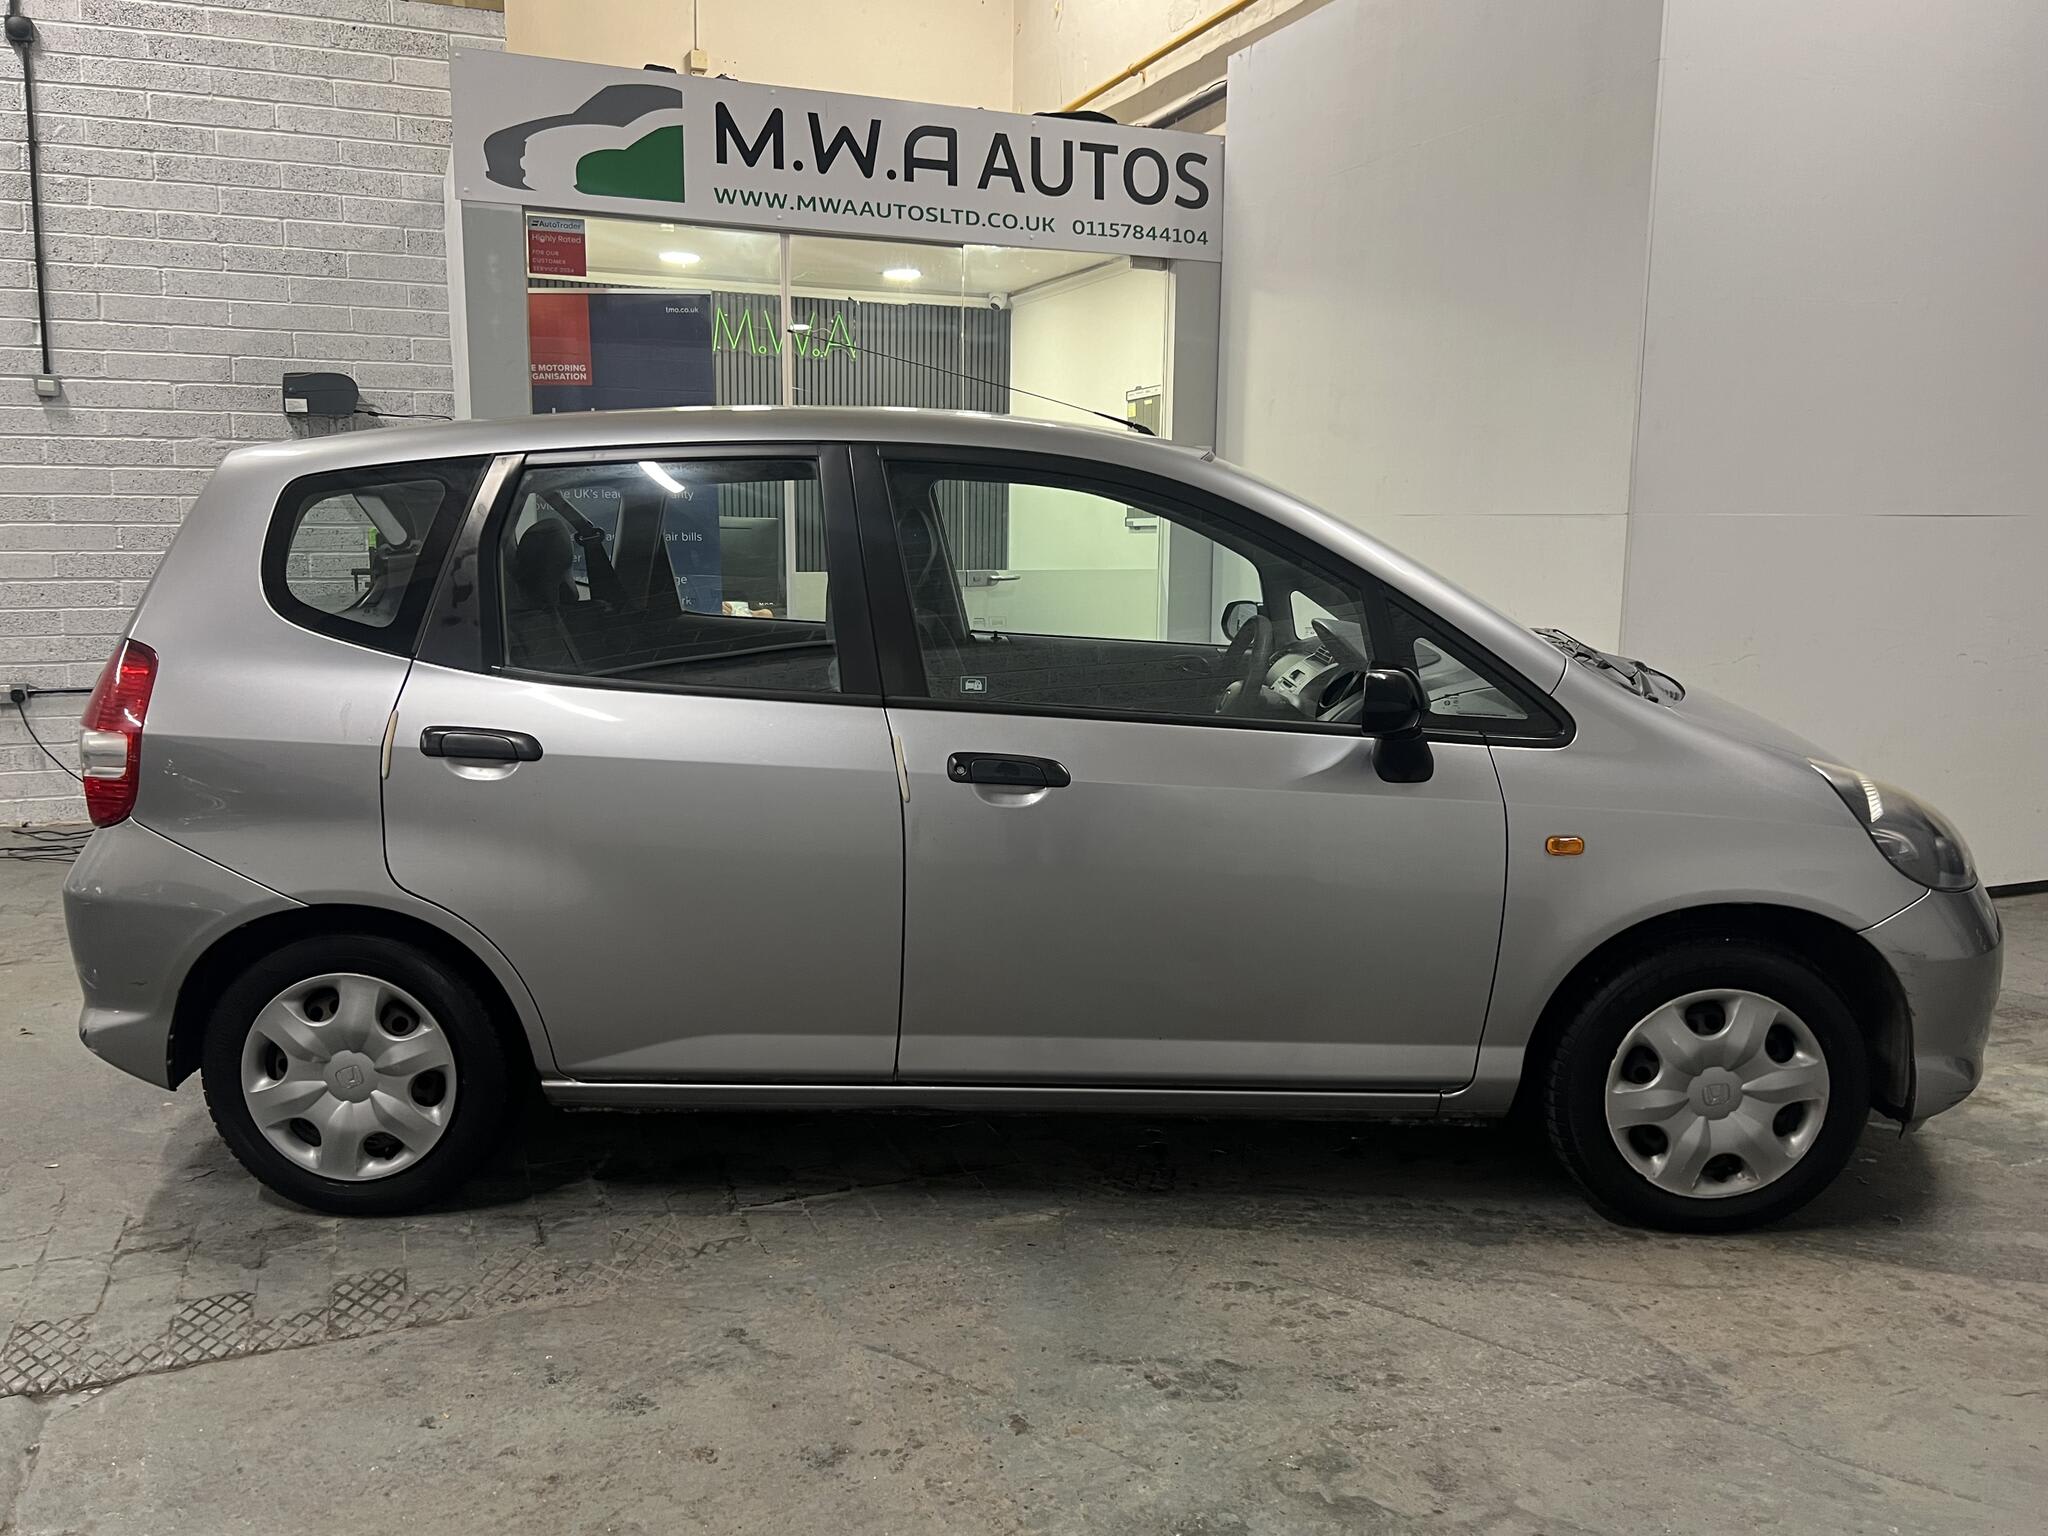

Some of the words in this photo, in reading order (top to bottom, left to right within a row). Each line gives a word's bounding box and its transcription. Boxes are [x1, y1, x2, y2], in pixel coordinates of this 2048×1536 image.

[715, 101, 958, 187] M.W.A
[977, 132, 1210, 210] AUTOS
[713, 187, 1056, 233] WWW.MWAAUTOSLTD.CO.UK
[1072, 219, 1209, 246] 01157844104
[539, 220, 581, 229] AutoTrader
[531, 233, 557, 243] Highly
[558, 235, 582, 244] Rated
[665, 305, 699, 314] tmo.co.uk
[538, 364, 587, 373] MOTORING
[532, 372, 588, 381] GANISATION
[681, 532, 703, 542] bills
